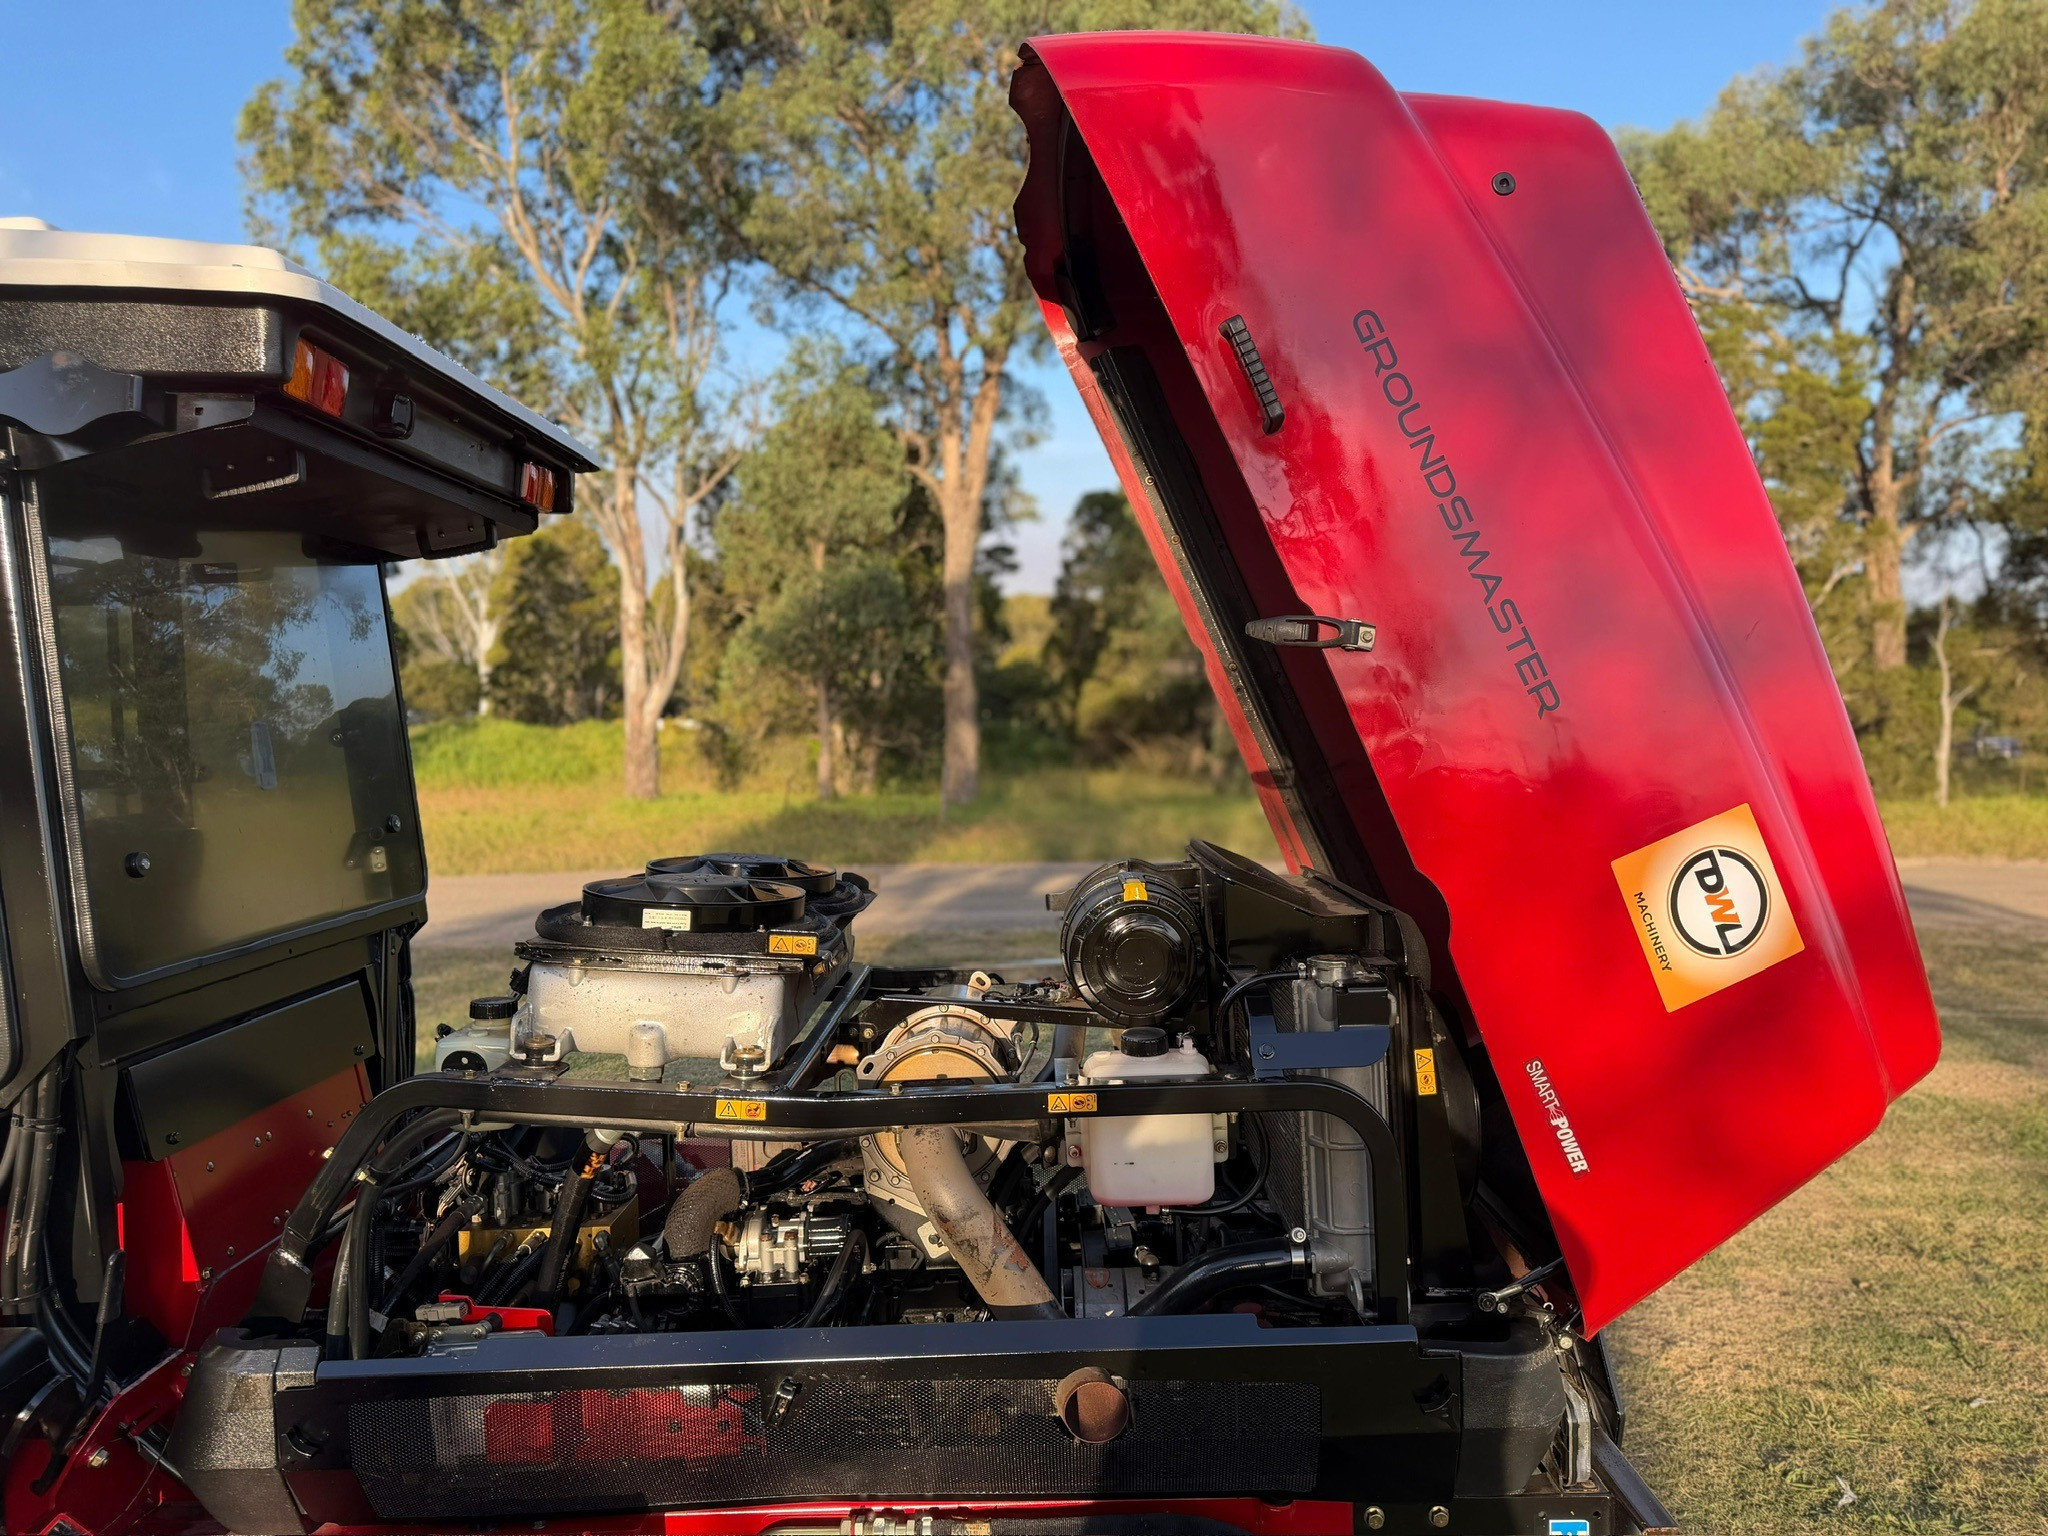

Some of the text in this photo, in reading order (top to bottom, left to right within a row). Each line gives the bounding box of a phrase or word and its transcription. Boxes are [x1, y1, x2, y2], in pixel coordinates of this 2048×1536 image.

[1352, 309, 1561, 721] GROUNDSMASTER
[1633, 891, 1673, 972] MACHINERY
[1694, 849, 1743, 955] DWL
[1526, 1060, 1589, 1173] SMART POWER
